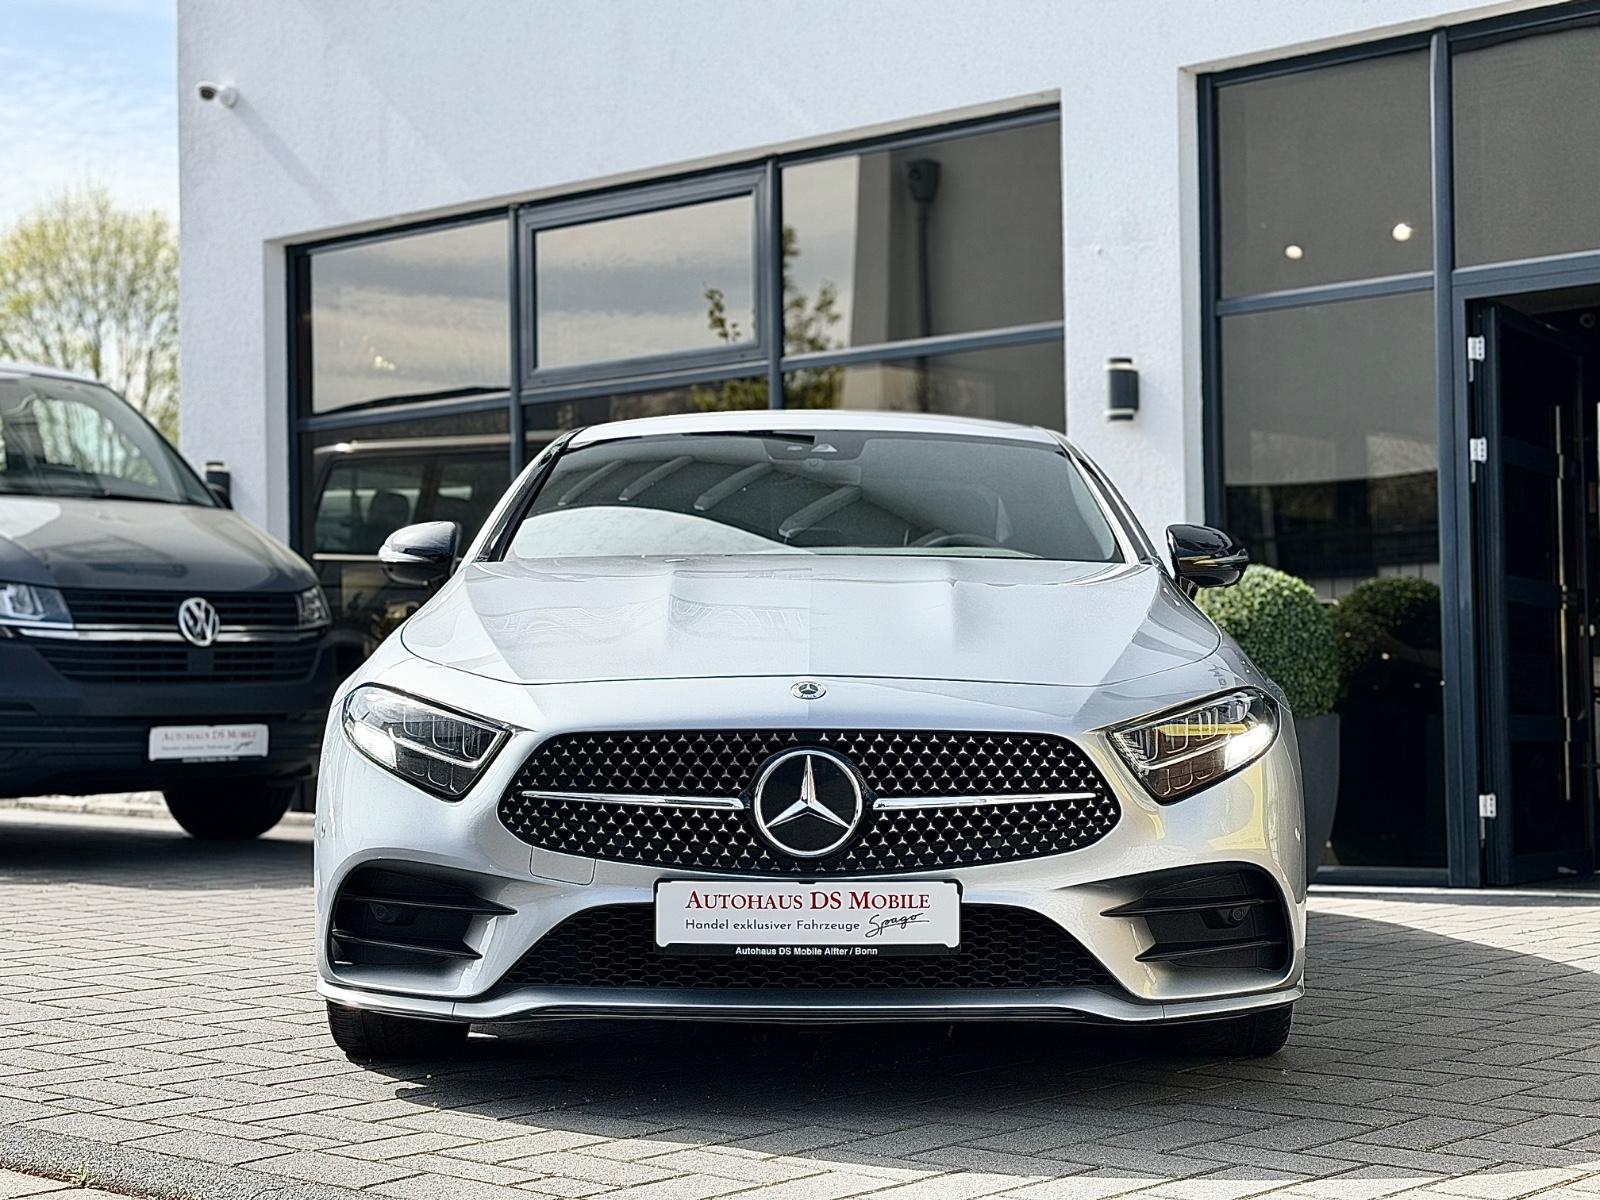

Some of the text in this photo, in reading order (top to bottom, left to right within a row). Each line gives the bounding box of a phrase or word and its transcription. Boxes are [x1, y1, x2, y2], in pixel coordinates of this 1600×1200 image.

[686, 891, 930, 910] AUTOHAUS DS MOBILE
[685, 919, 860, 933] Handel exklusiver Fahrzeuge
[865, 913, 930, 937] Spago
[736, 947, 776, 956] Autohaus
[778, 947, 791, 956] DS
[793, 947, 822, 956] Mobile
[824, 947, 848, 956] Alfter
[855, 947, 877, 956] Bonn
